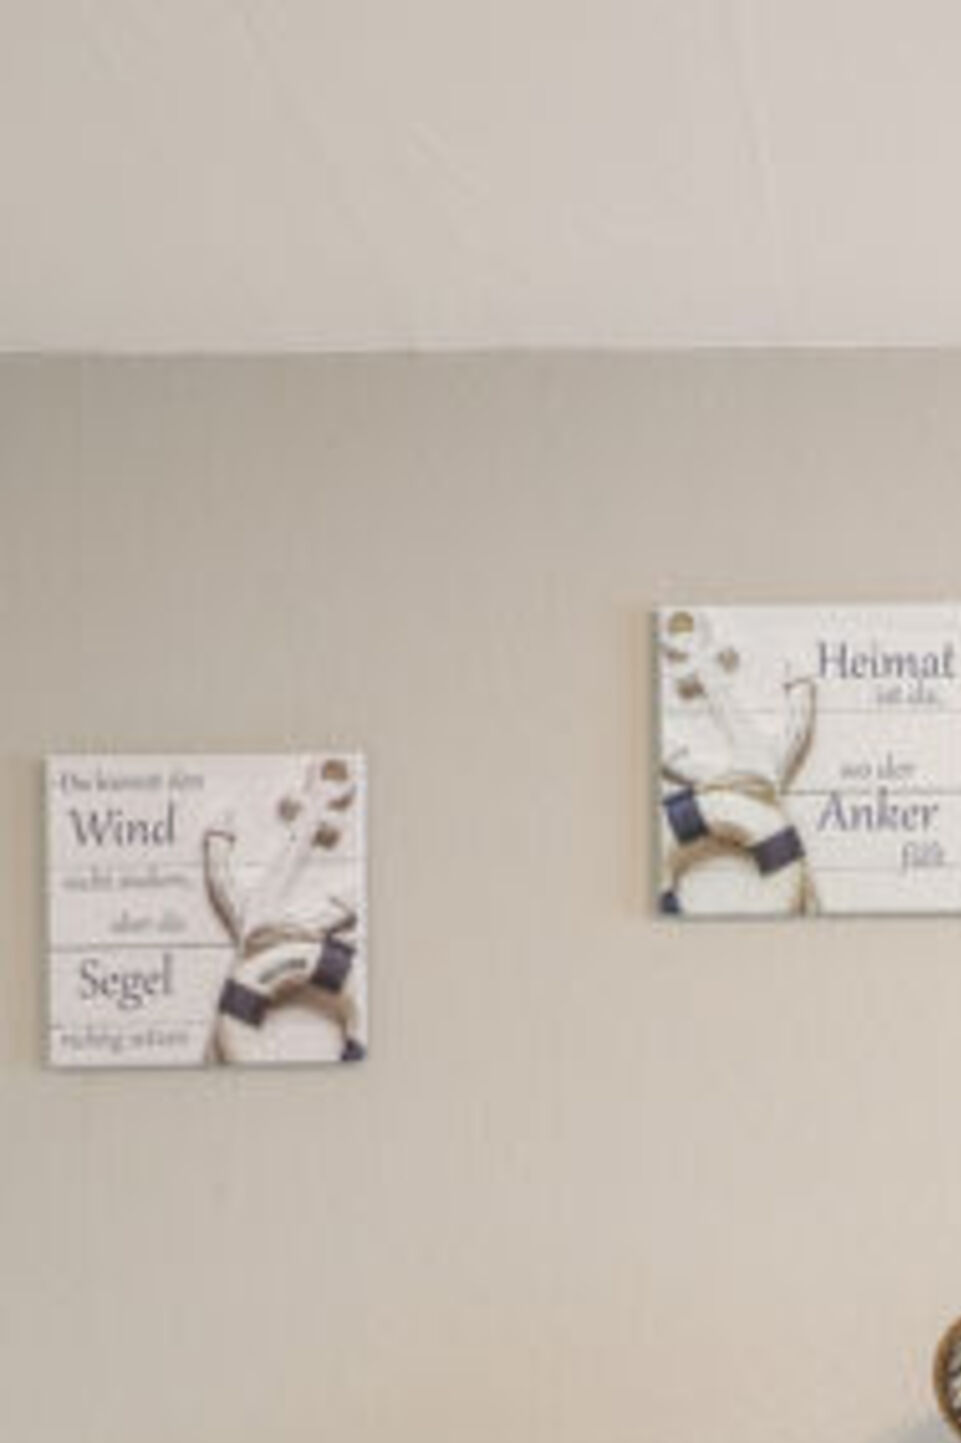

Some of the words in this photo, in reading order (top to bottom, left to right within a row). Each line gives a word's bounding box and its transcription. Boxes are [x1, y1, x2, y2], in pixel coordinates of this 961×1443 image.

[817, 638, 955, 679] Heimat
[68, 798, 174, 847] Wind
[815, 786, 940, 832] Anker
[79, 952, 173, 1011] Segel
